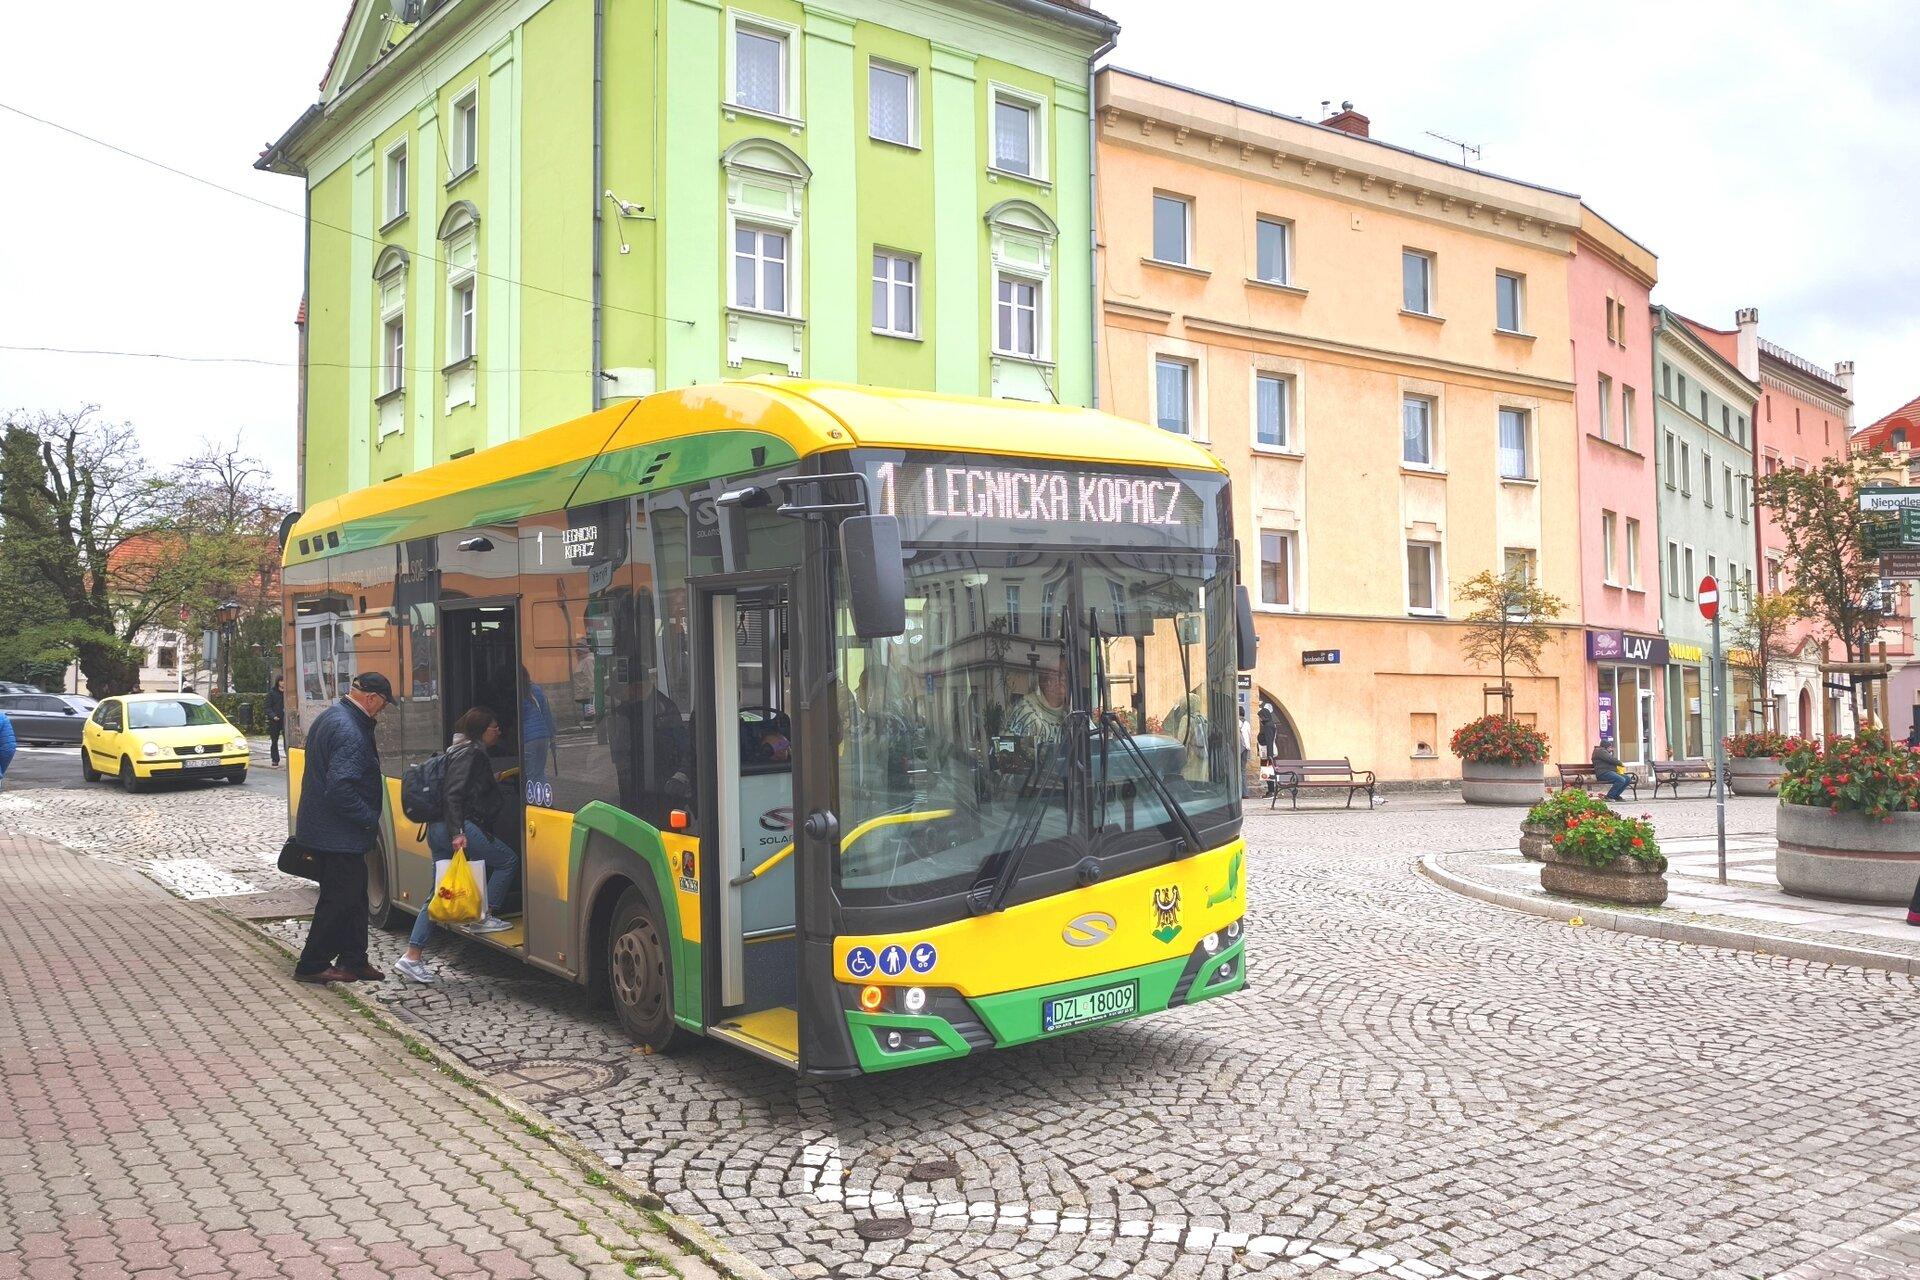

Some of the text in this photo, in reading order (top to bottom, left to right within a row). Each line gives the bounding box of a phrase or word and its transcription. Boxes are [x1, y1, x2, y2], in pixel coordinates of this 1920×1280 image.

[877, 462, 1182, 525] 1 LEGNICKA KOPACZ
[537, 531, 543, 566] 1
[562, 526, 598, 543] LEGNICKA
[564, 542, 595, 559] KOPACZ
[1623, 637, 1652, 660] LAY
[1054, 999, 1082, 1022] DZL
[1089, 987, 1132, 1014] 18009
